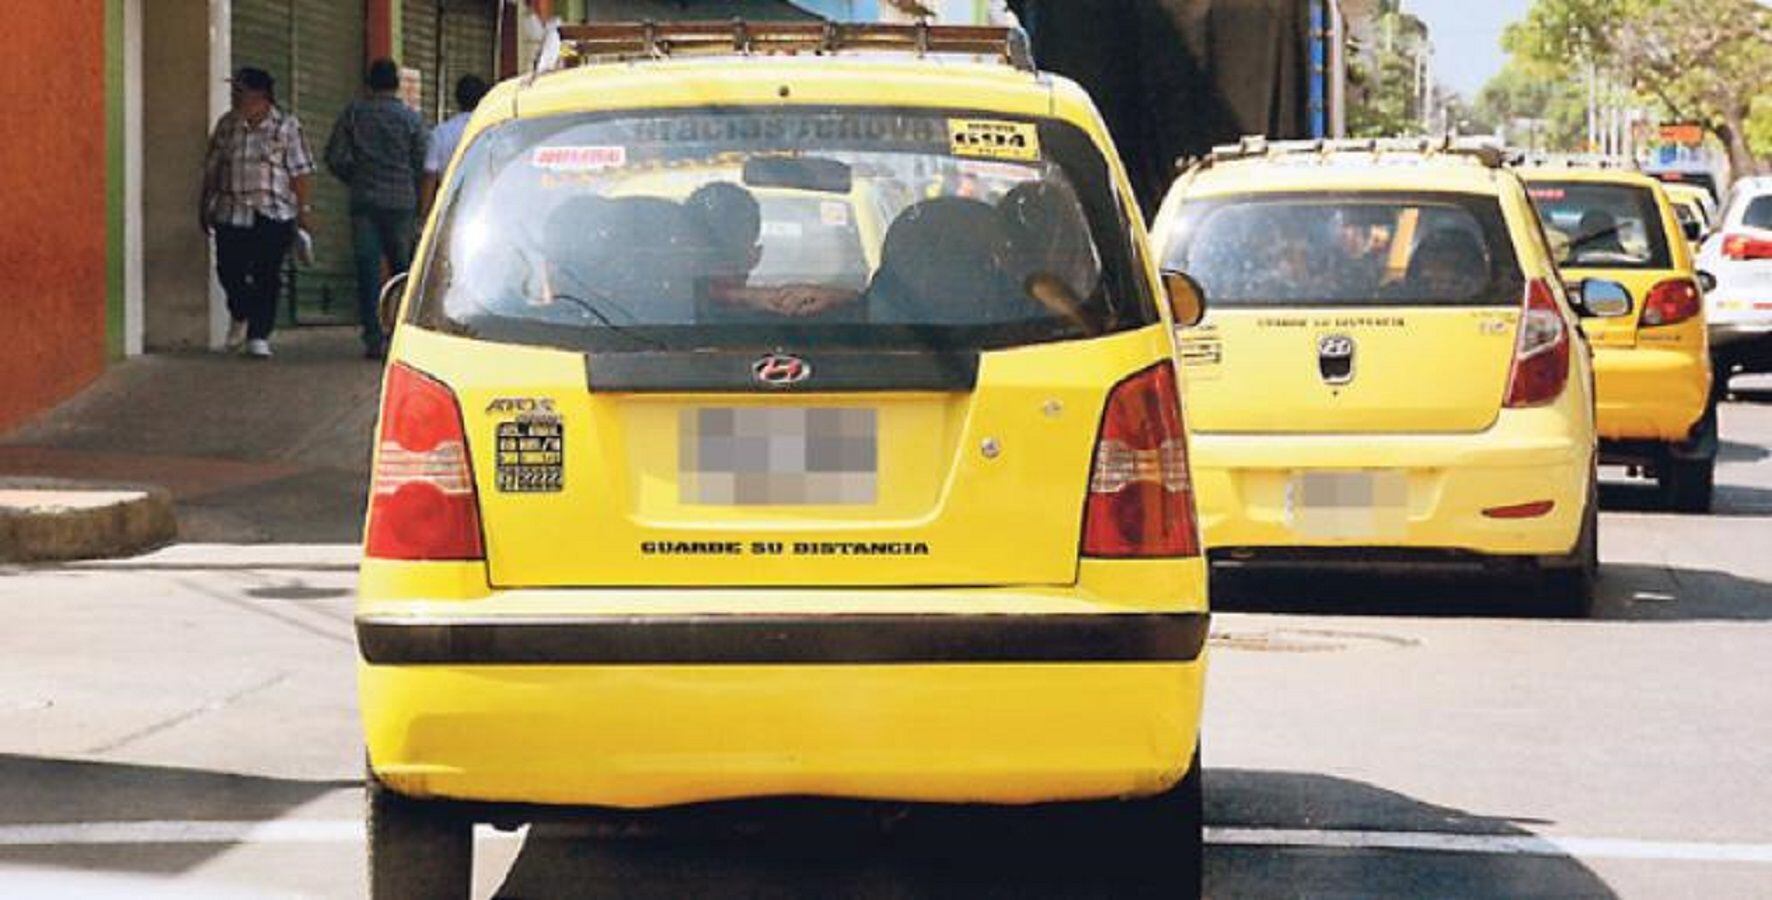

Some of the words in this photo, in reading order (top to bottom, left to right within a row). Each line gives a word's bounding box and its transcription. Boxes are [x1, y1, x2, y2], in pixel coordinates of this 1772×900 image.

[640, 541, 742, 555] GUARDE
[751, 541, 783, 555] SU
[793, 541, 930, 555] DISTANCIA
